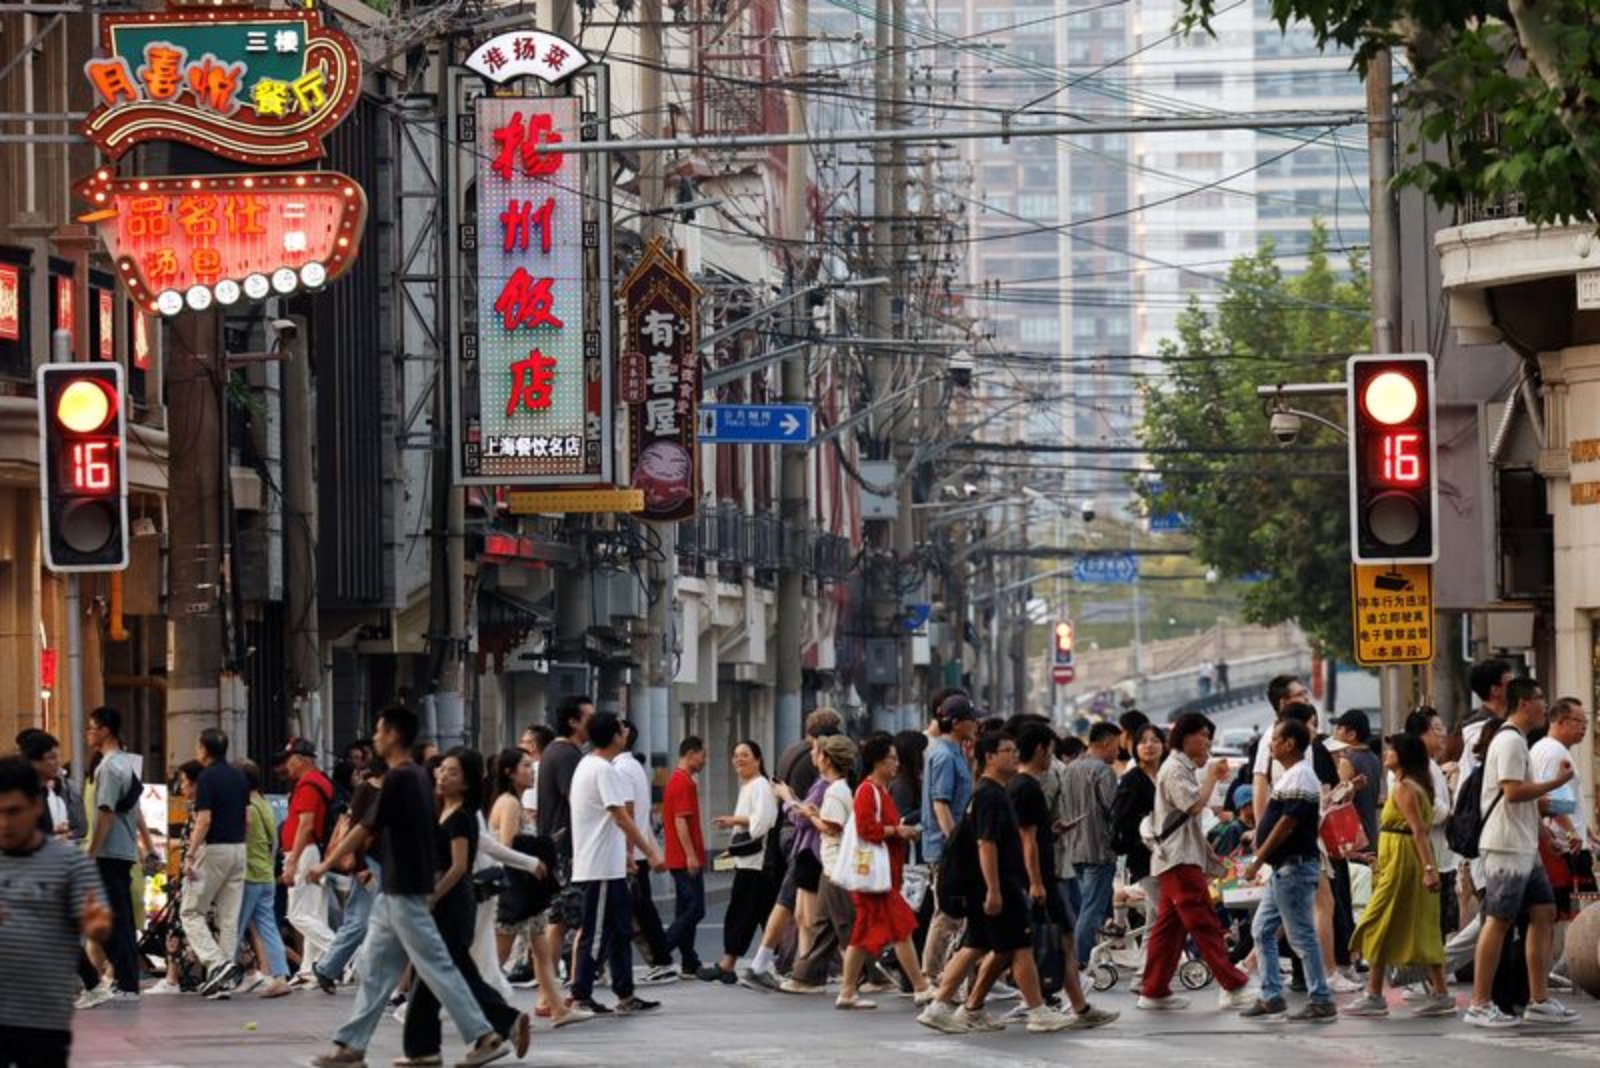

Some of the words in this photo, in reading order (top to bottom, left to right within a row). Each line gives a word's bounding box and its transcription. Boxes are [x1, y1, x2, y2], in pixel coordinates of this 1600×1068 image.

[482, 37, 570, 74] 淮扬菜
[640, 309, 681, 438] 有喜屋
[74, 442, 110, 489] 16
[483, 436, 580, 458] 上海餐饮名店
[1384, 434, 1419, 480] 16
